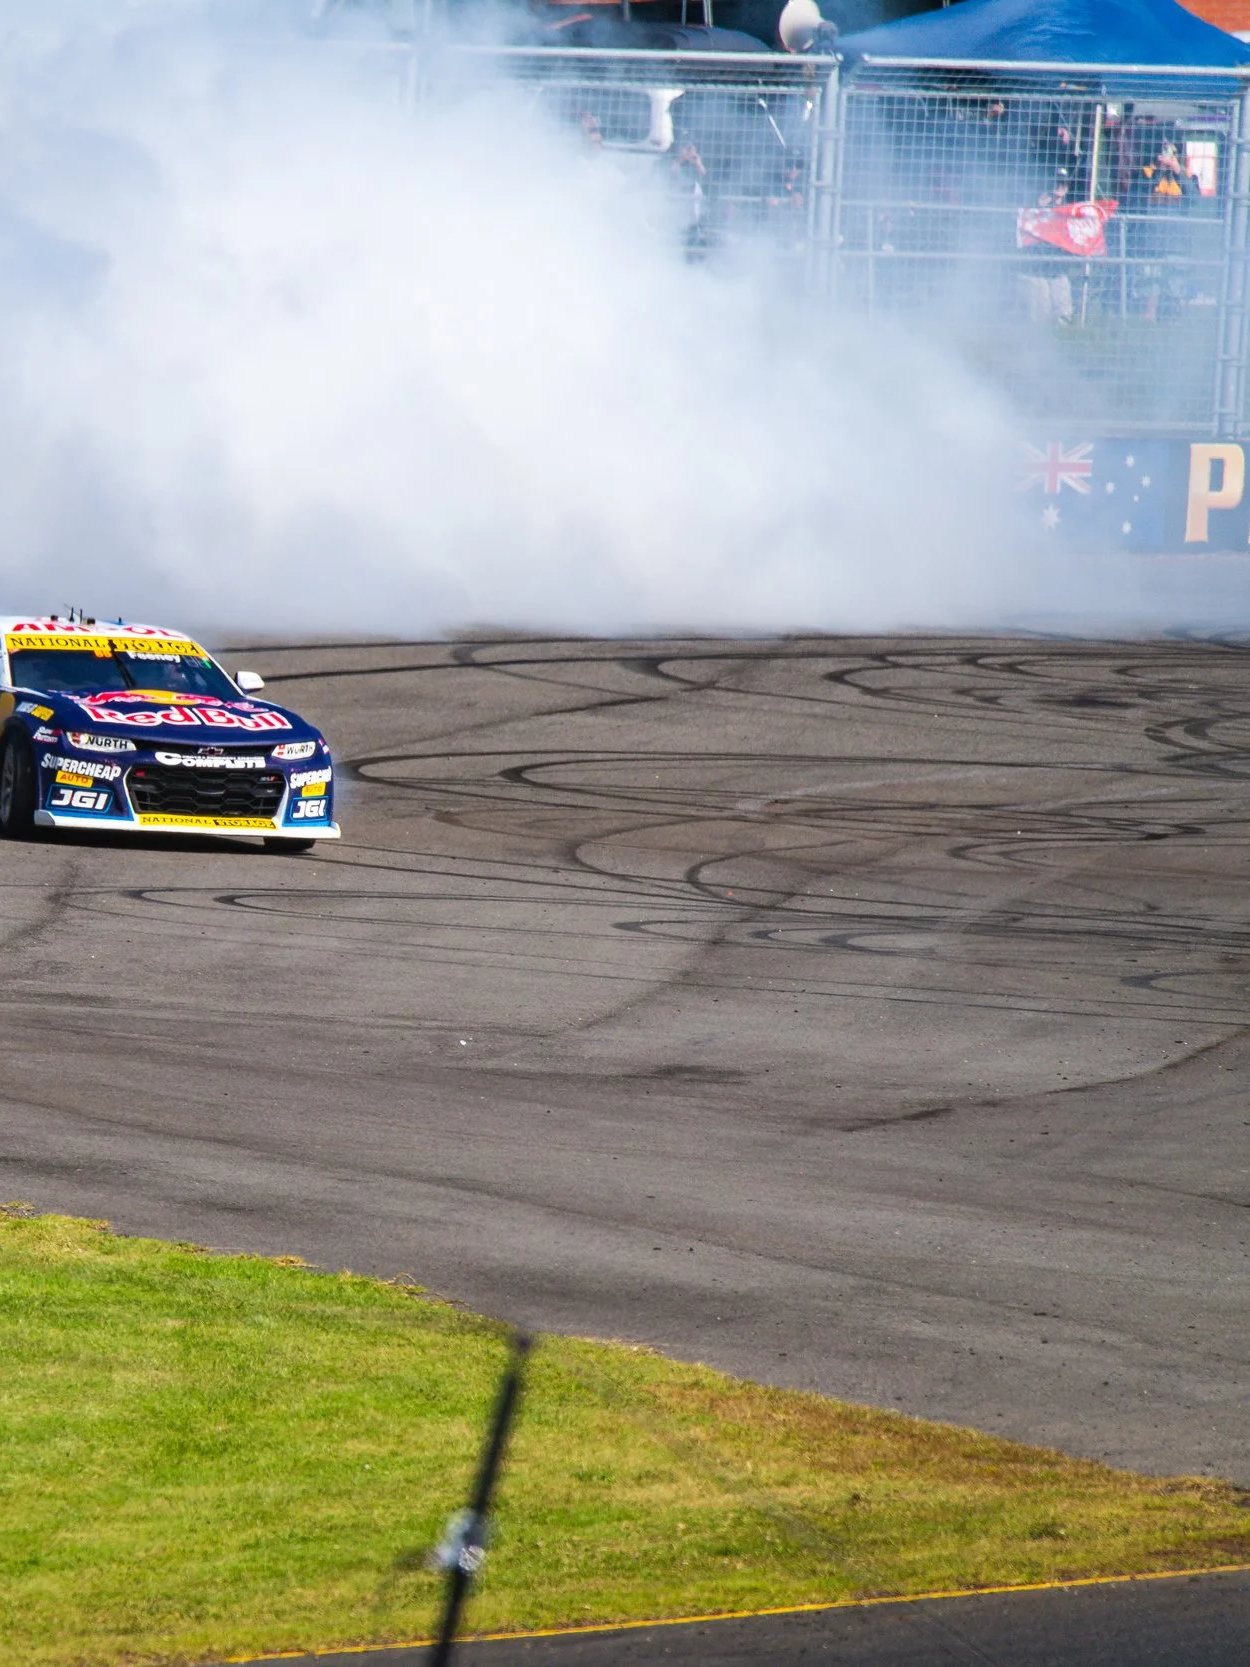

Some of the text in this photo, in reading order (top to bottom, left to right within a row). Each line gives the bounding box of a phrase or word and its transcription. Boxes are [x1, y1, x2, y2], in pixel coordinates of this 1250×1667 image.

[10, 637, 106, 649] NATIONAL
[41, 753, 122, 781] SUPERCHEAP
[60, 774, 89, 784] AUTO
[51, 788, 108, 810] JGI
[293, 799, 326, 818] JGI
[143, 816, 211, 825] NATIONAL
